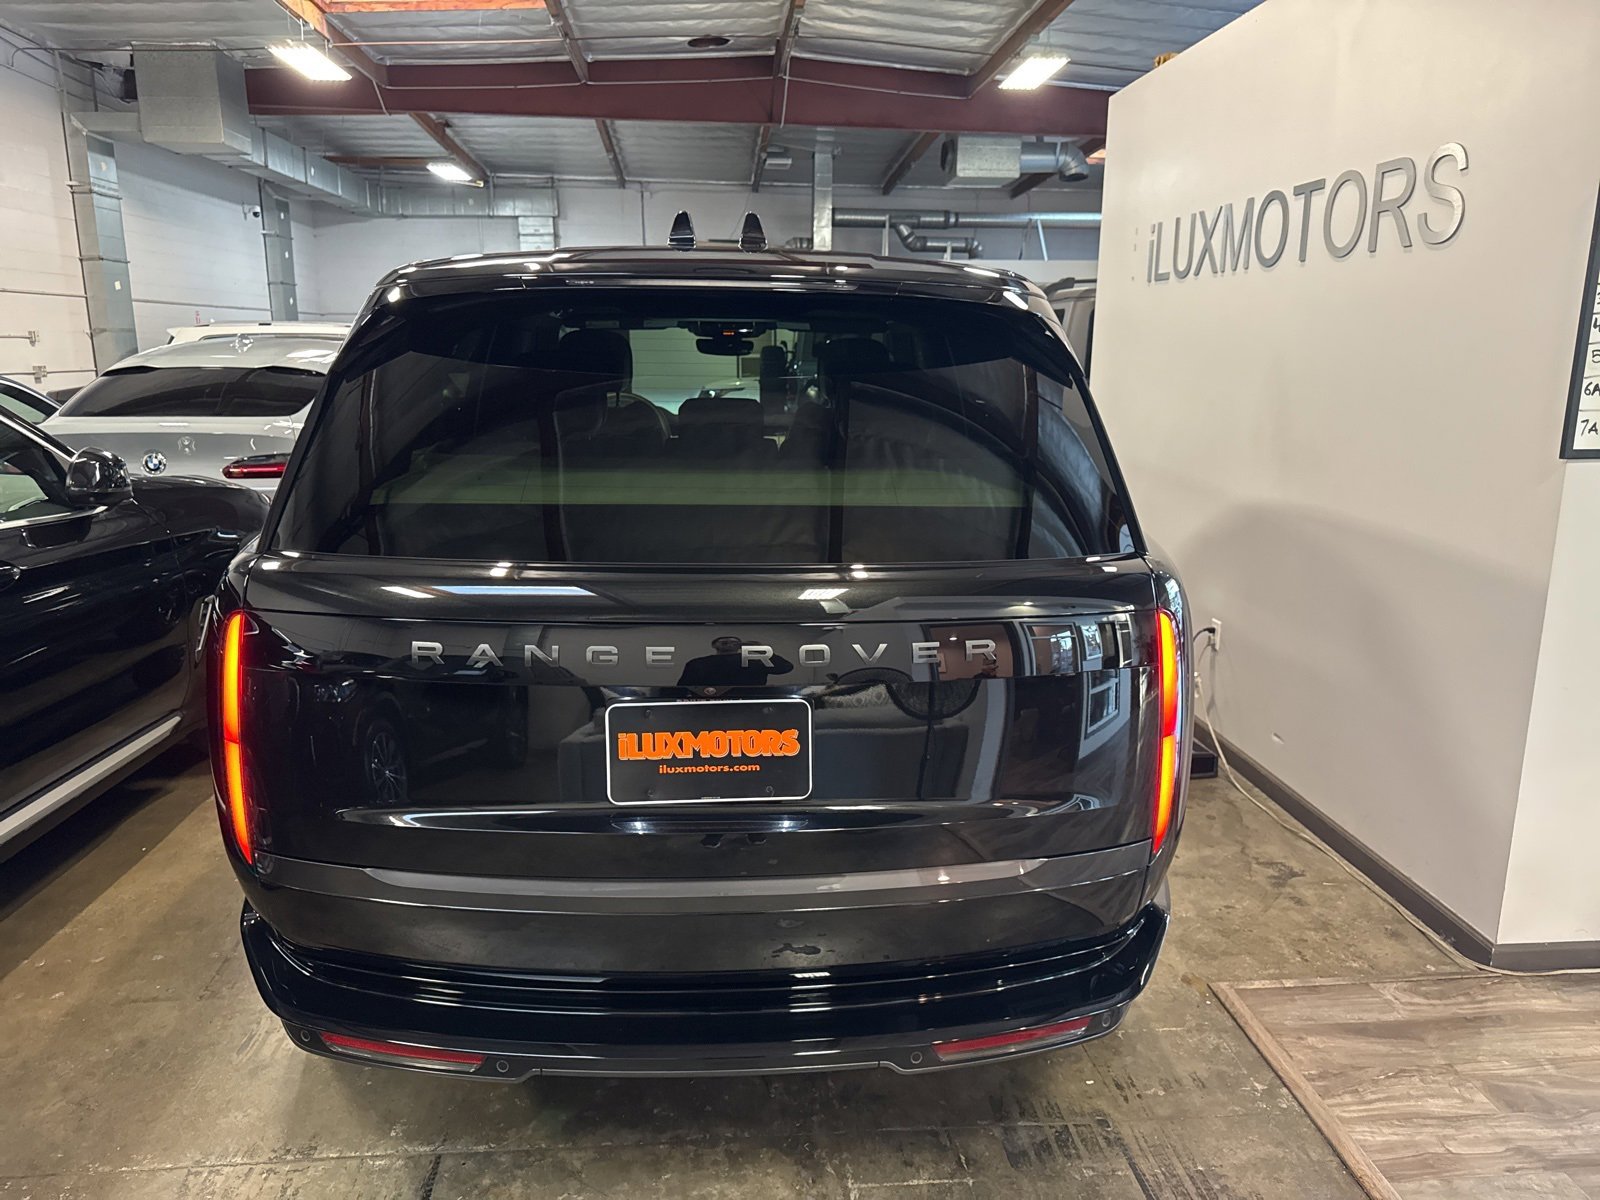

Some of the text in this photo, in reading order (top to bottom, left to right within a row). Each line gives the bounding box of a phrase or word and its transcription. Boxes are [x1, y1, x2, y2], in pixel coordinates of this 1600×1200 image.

[1147, 142, 1469, 283] iLUXMOTORS
[1581, 419, 1599, 436] 7A
[411, 639, 997, 668] RANGE ROVER
[617, 728, 801, 760] iLUXMOTORS
[658, 763, 761, 775] iluxmotors.com
